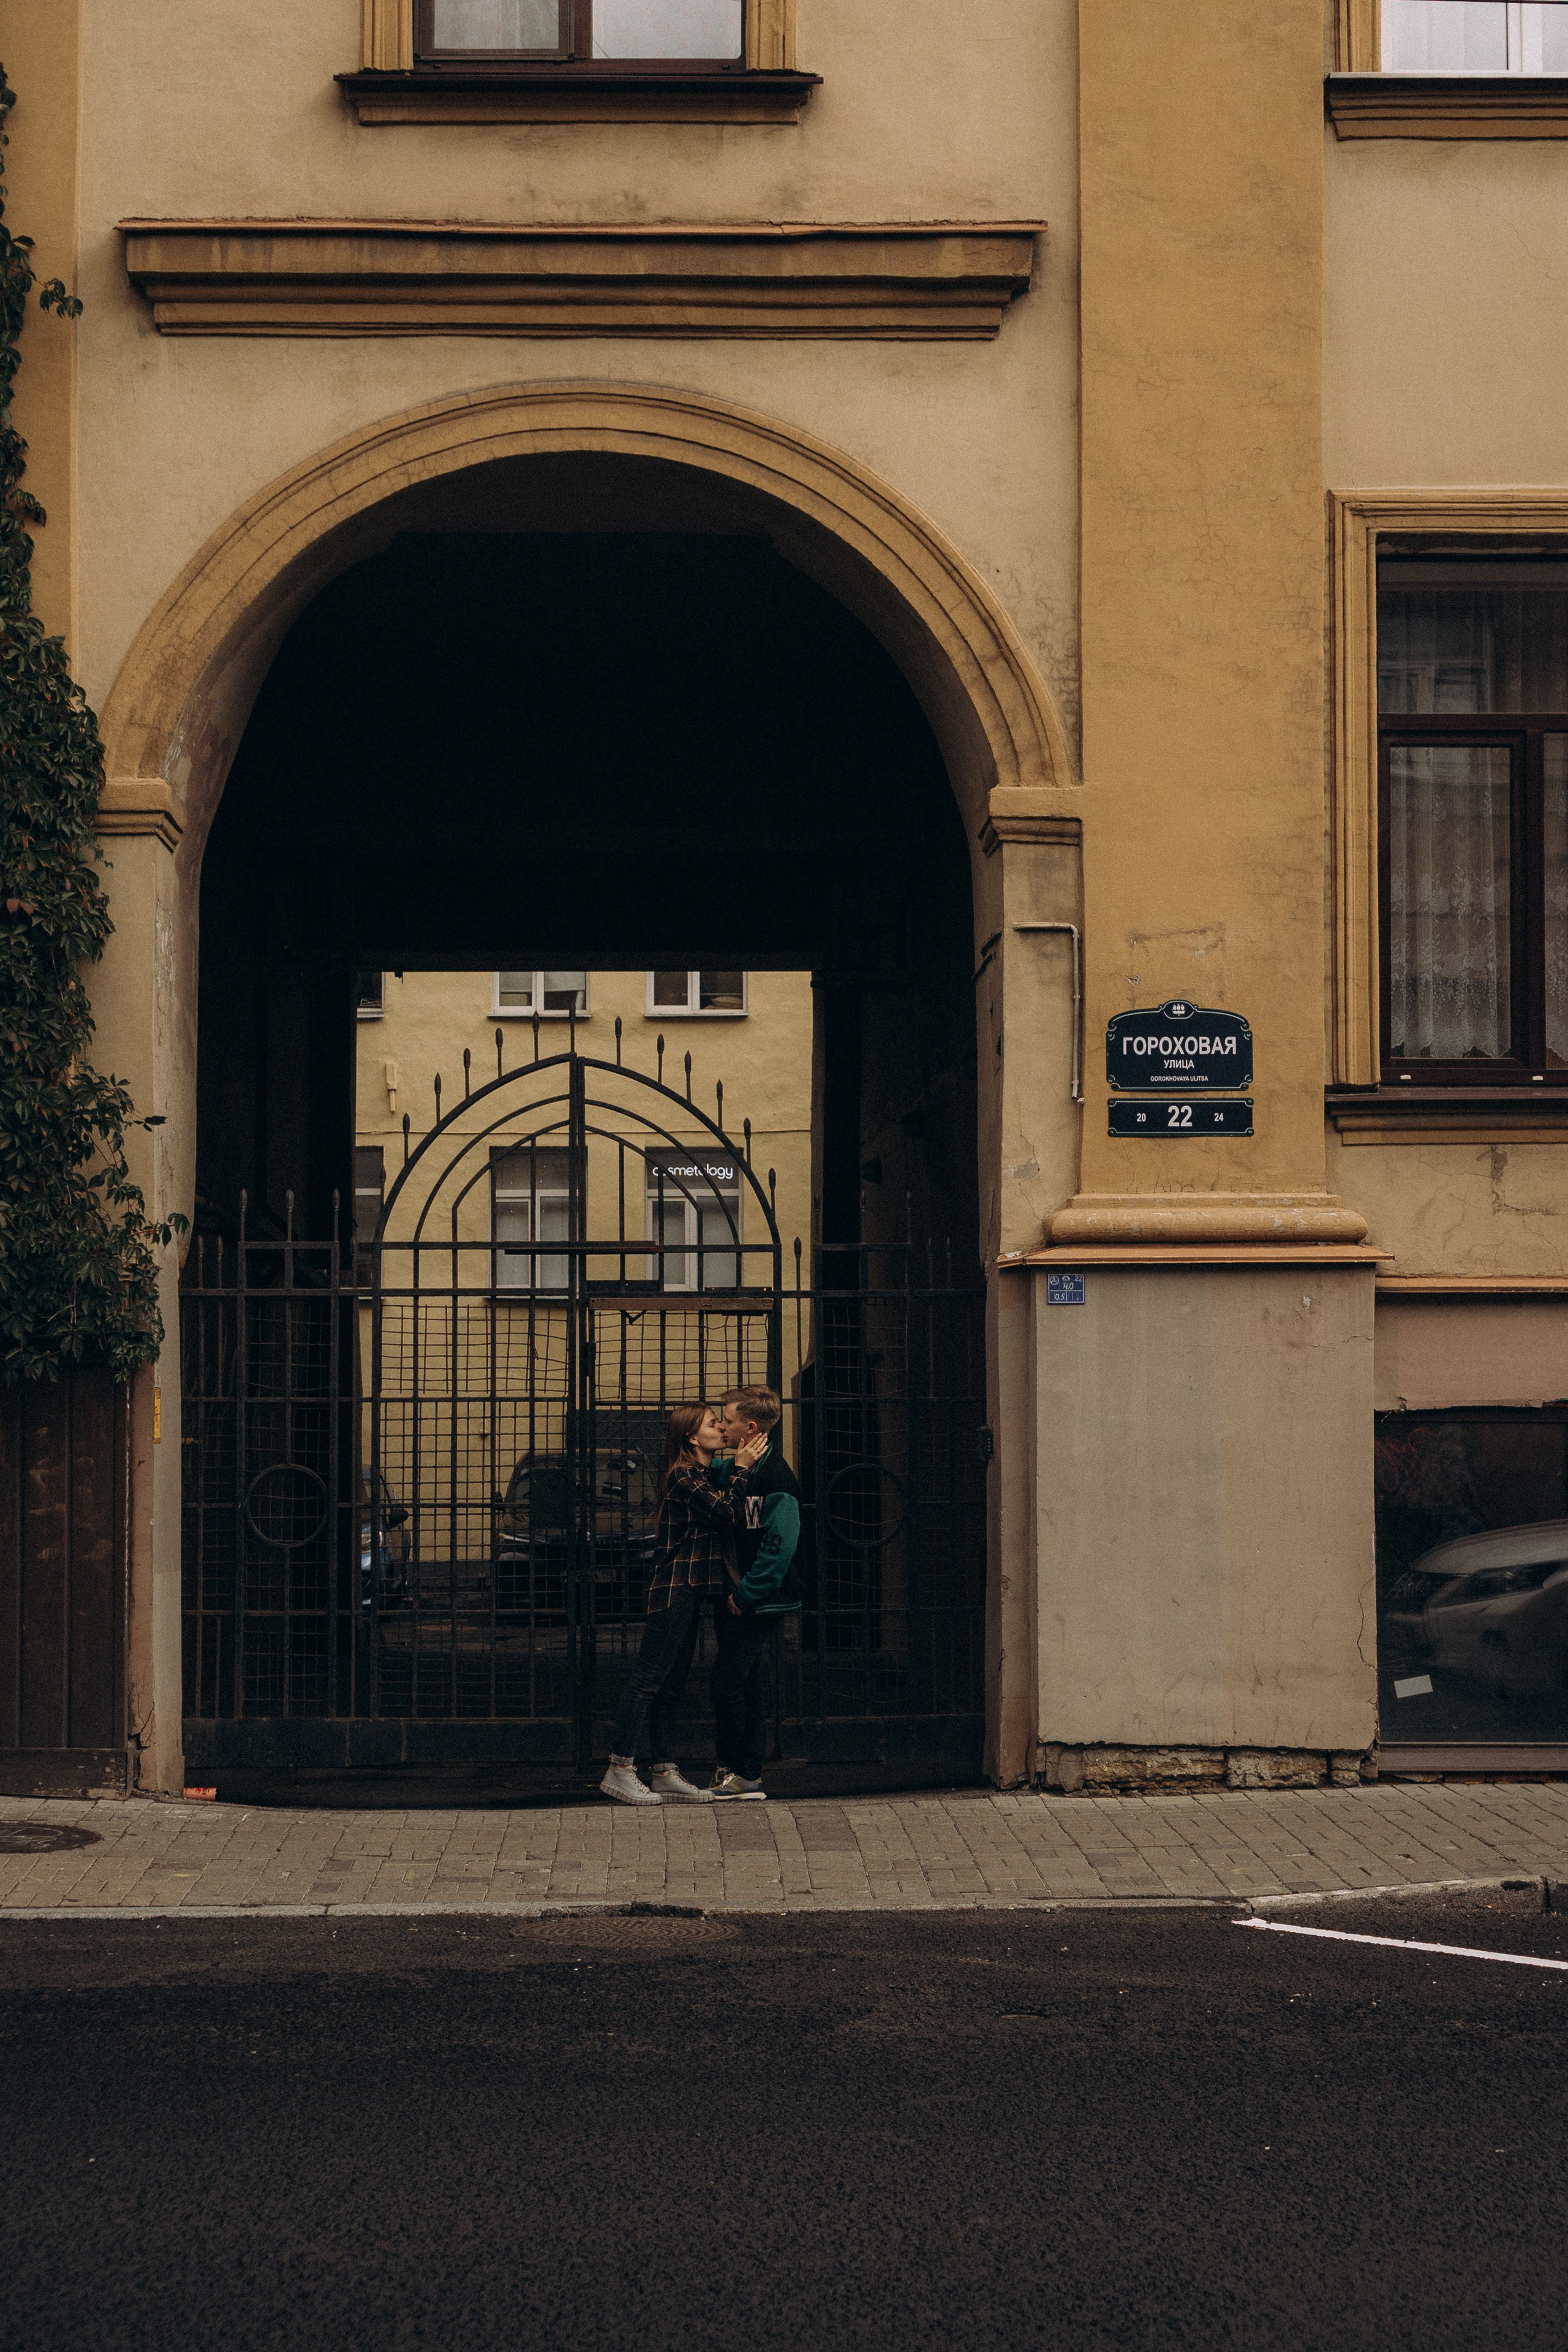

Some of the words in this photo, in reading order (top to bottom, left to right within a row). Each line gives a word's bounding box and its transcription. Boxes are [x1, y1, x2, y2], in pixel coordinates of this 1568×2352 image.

[1123, 1036, 1236, 1055] ГОРОХОВАЯ
[1164, 1060, 1194, 1069] УЛИЦА
[1167, 1106, 1193, 1126] 22
[652, 1164, 733, 1179] csmetlogy
